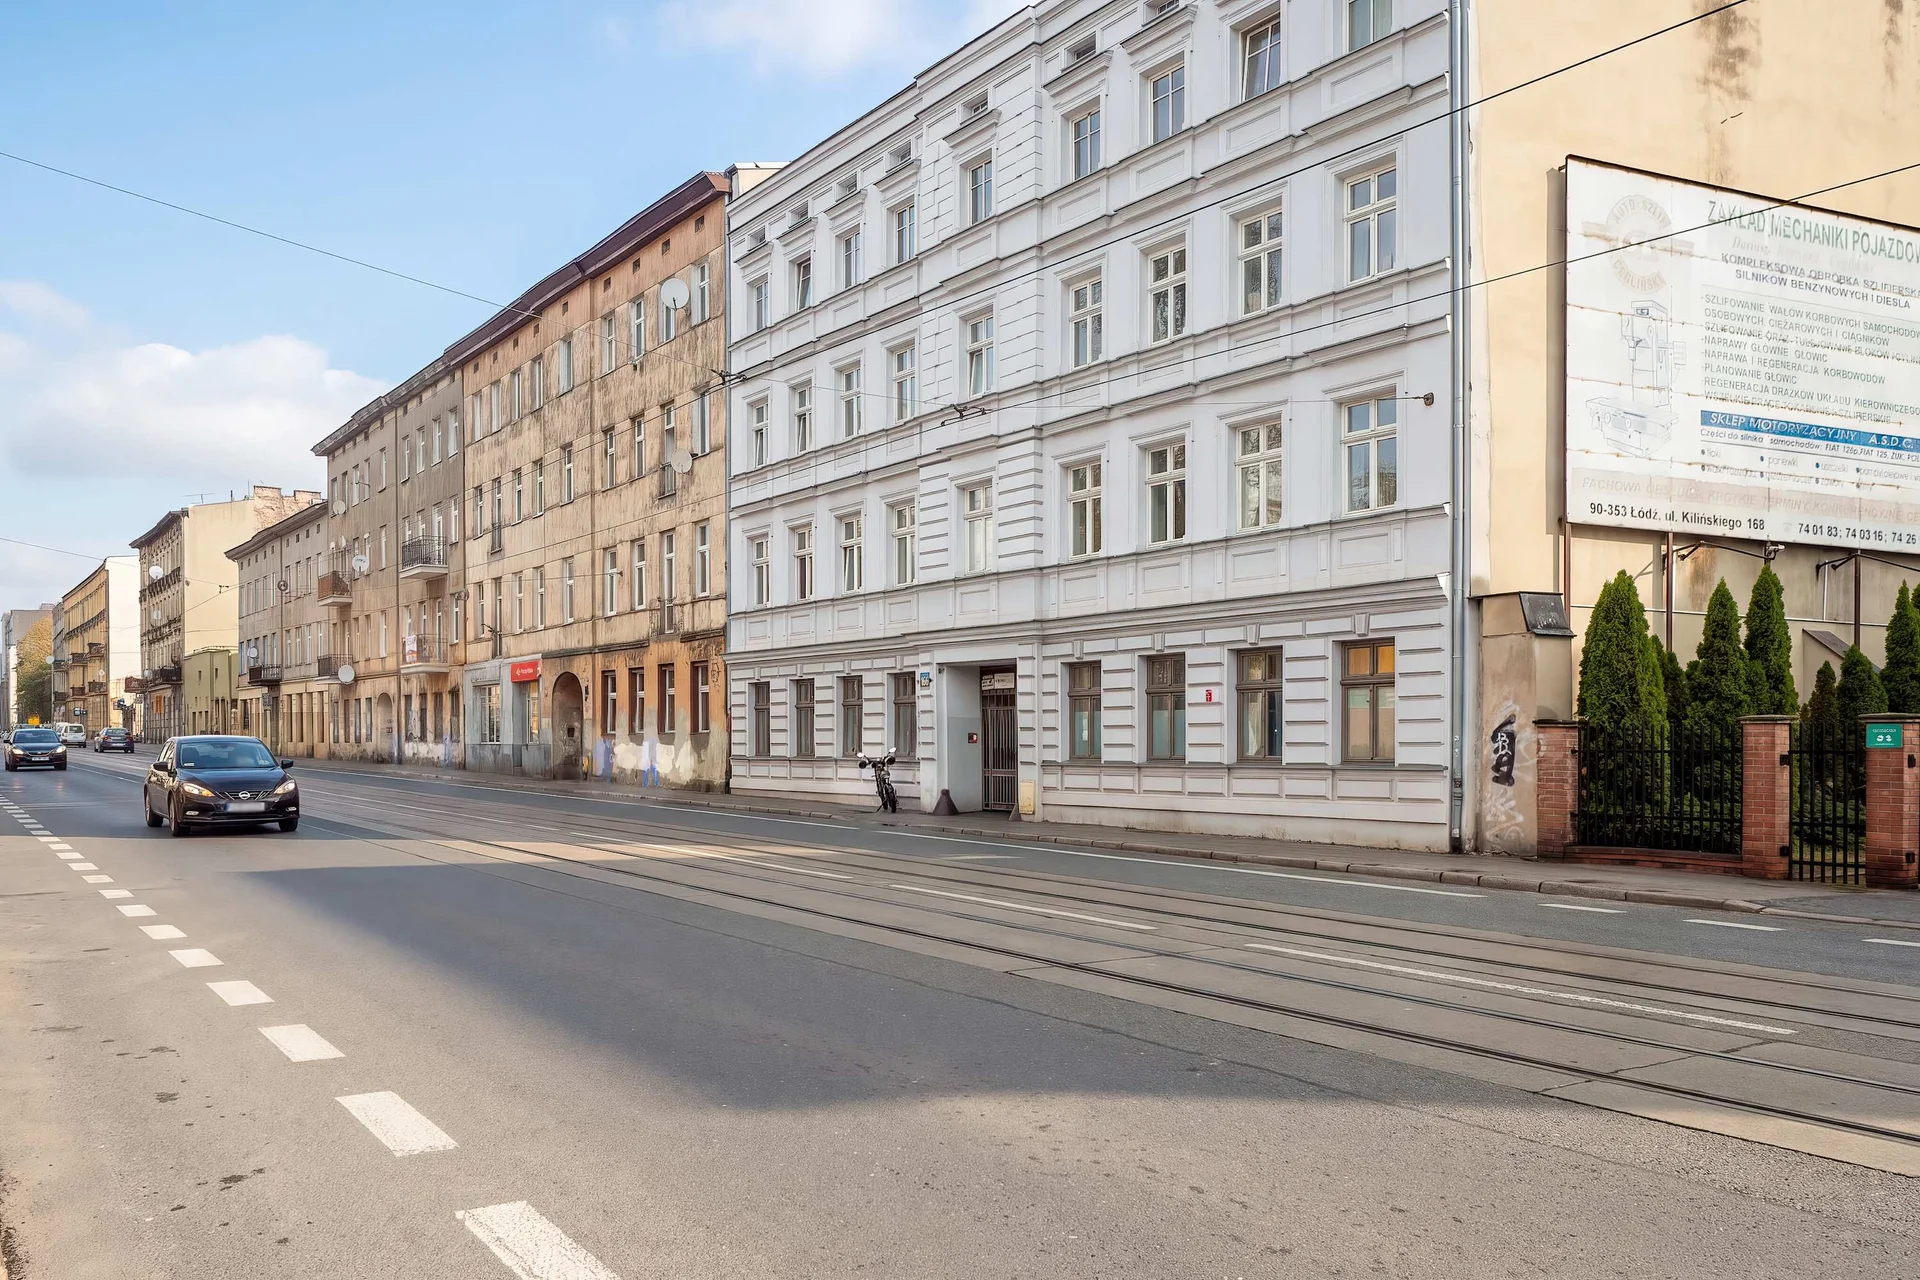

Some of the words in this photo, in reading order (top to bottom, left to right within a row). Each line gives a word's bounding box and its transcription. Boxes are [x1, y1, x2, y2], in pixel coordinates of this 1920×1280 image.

[1771, 213, 1848, 250] MECHANIKI
[1721, 253, 1806, 277] KOMPLEKSOWA
[1791, 279, 1868, 301] BENZYNOWYCH
[1876, 295, 1911, 309] DIESLA
[1805, 312, 1860, 328] KORBOWYCH
[1757, 357, 1820, 375] REGENERACJA
[1854, 397, 1920, 415] KIEROWNICZEGO
[1710, 413, 1745, 427] SKLEP
[1749, 418, 1857, 441] MOTORYZACYJNY
[1727, 431, 1738, 440] do
[1740, 433, 1764, 443] silnika
[1582, 477, 1641, 493] FACHOWA
[1590, 502, 1627, 517] 90-353
[1665, 511, 1678, 522] ul.
[1682, 511, 1742, 530] Kilińskiego
[1747, 518, 1765, 530] 168
[1798, 523, 1810, 534] 74
[1812, 524, 1823, 535] 01
[1845, 527, 1857, 539] 74
[1860, 529, 1871, 540] 03
[1891, 532, 1902, 542] 74
[1906, 534, 1917, 544] 26
